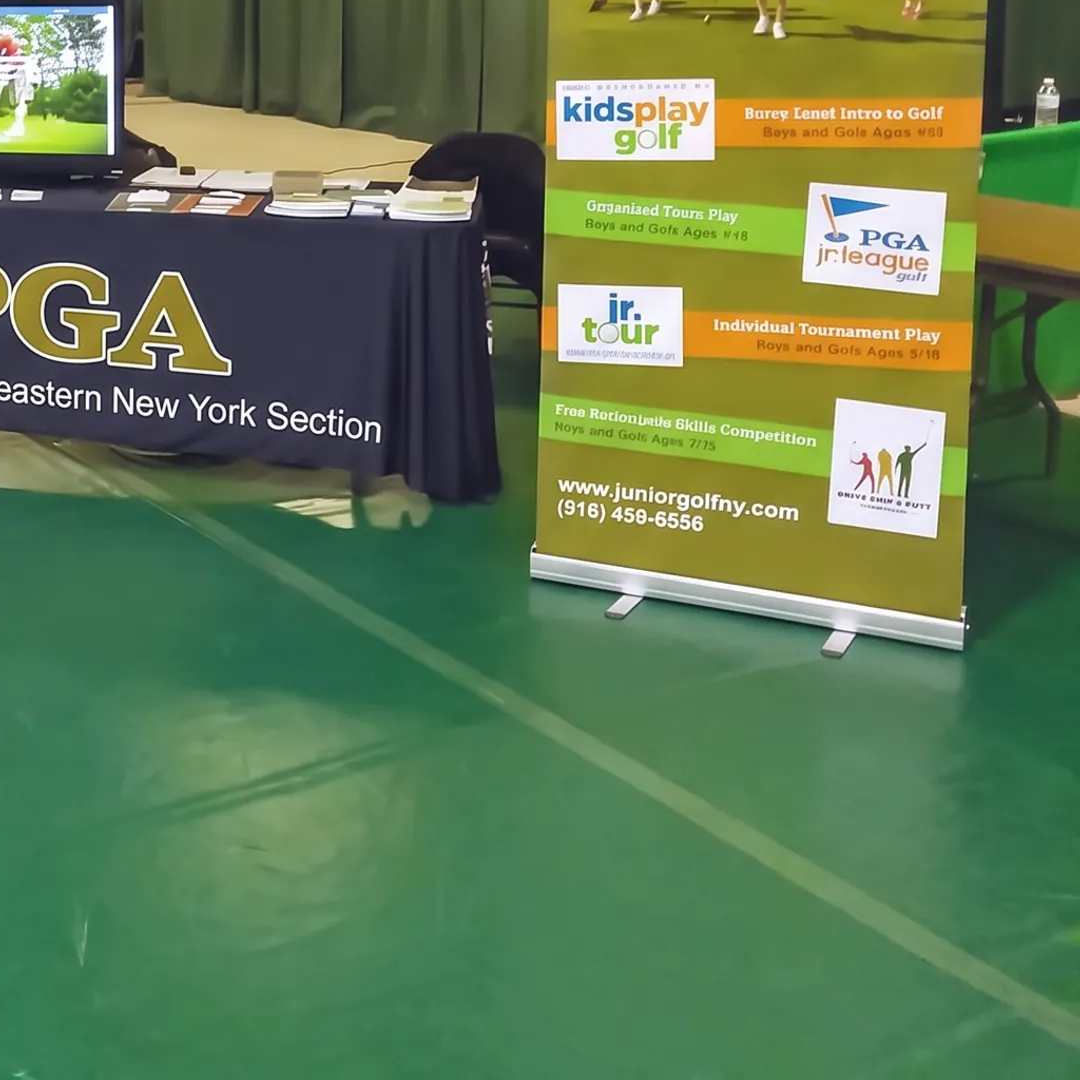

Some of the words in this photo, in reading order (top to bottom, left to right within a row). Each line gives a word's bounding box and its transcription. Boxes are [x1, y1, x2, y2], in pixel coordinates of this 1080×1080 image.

[563, 96, 709, 128] kidsplay
[840, 107, 882, 120] Intro
[886, 108, 903, 120] to
[907, 106, 944, 120] Golf
[614, 122, 683, 155] golf
[802, 126, 829, 138] and
[708, 209, 739, 225] Play
[585, 219, 616, 233] Boys
[620, 222, 644, 233] and
[683, 226, 717, 240] Ages
[859, 229, 930, 252] PGA
[609, 293, 641, 324] jr.
[581, 317, 660, 345] tour
[713, 319, 795, 335] Individual
[799, 322, 901, 341] Tournament
[905, 328, 942, 345] Play
[796, 343, 822, 354] and
[112, 386, 179, 419] New
[188, 393, 256, 428] York
[267, 402, 382, 444] Section
[589, 426, 613, 438] and
[720, 423, 817, 447] Competition
[557, 499, 606, 524] (916)
[558, 478, 799, 521] www.juniorgolfny.com
